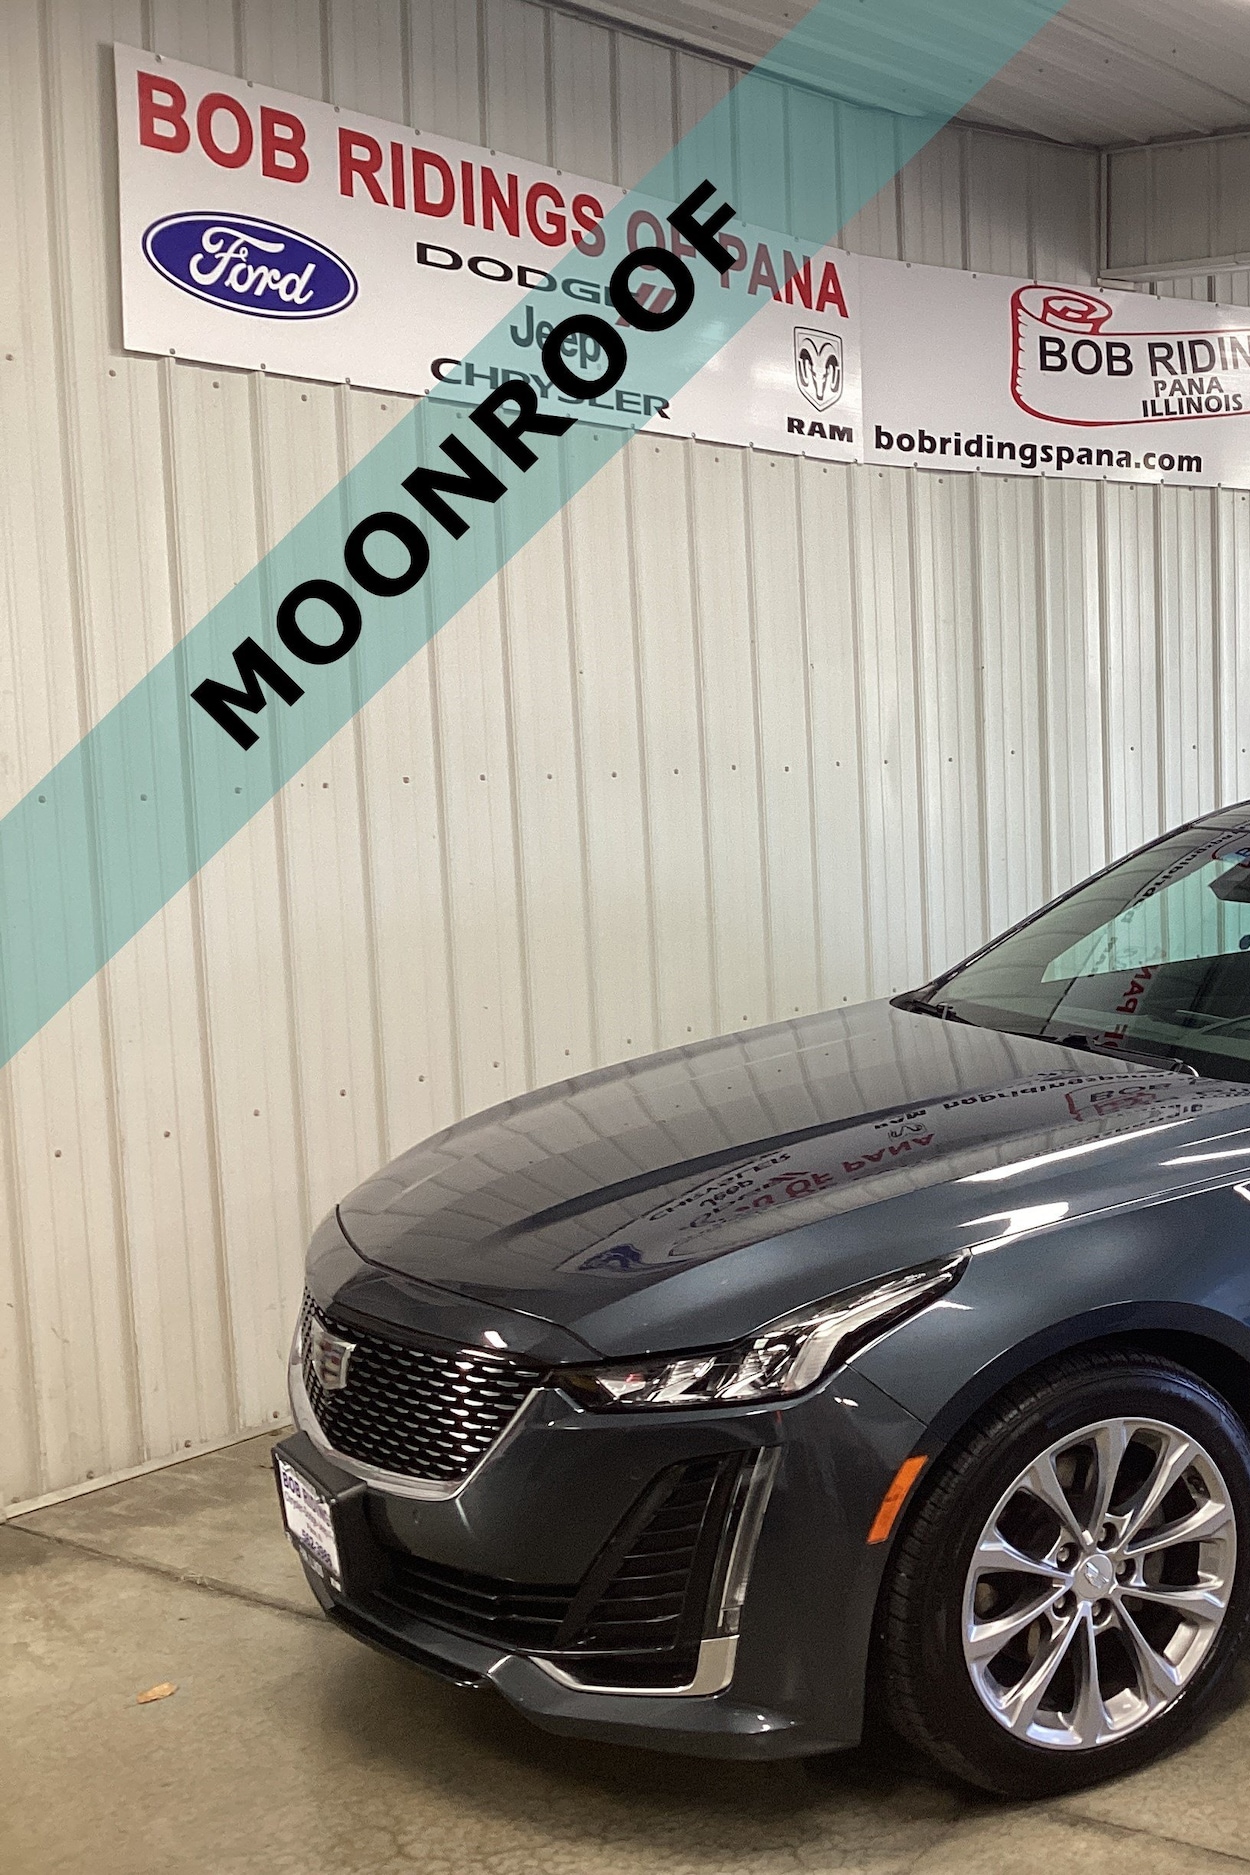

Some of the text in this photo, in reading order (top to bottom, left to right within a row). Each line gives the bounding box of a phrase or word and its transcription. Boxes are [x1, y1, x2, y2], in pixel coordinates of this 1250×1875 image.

[137, 69, 310, 185] BOB
[338, 125, 606, 257] RIDINGS
[718, 231, 849, 318] PANA
[188, 224, 316, 306] Ford
[1038, 334, 1134, 377] BOB
[1141, 392, 1243, 418] ILLINOIS
[1153, 375, 1225, 398] PANA
[786, 416, 854, 443] RAM
[874, 425, 1203, 473] bobridingspana.com
